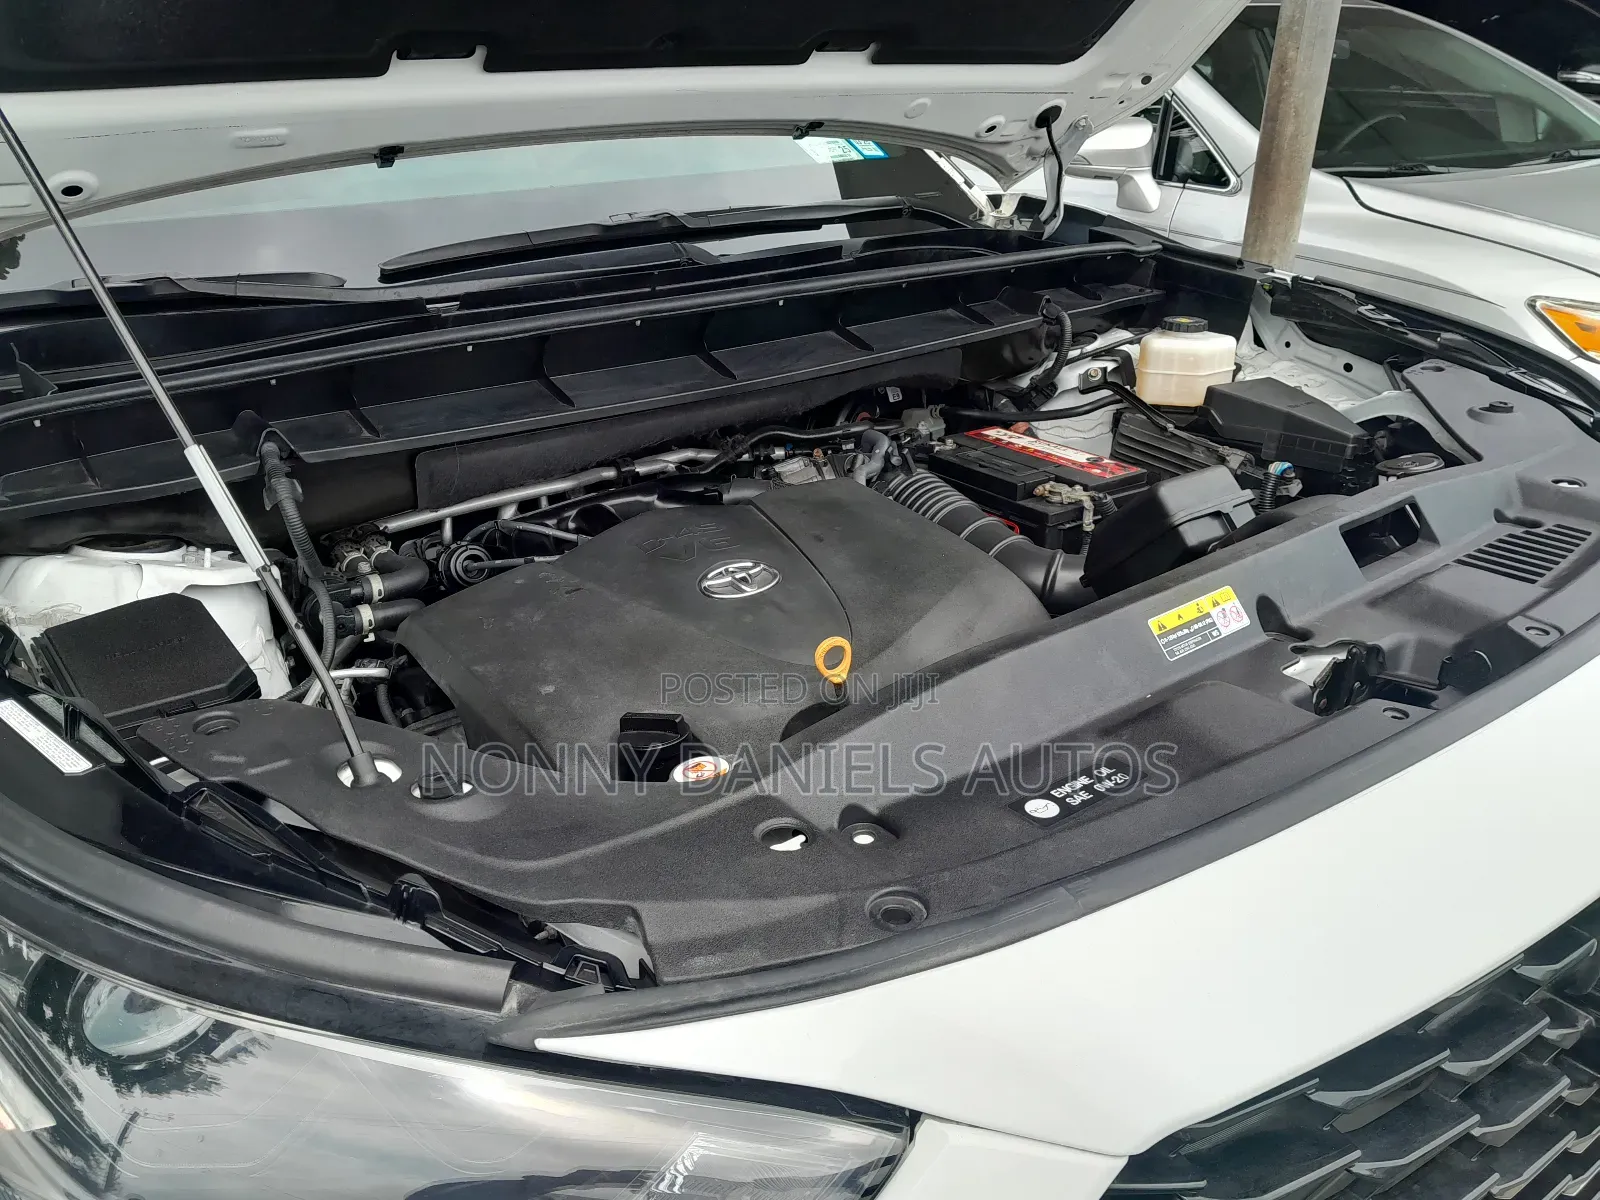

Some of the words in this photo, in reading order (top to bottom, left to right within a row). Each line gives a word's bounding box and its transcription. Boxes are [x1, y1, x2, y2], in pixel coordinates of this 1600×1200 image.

[1049, 775, 1094, 798] ENGINE
[1093, 766, 1116, 777] OIL
[1065, 790, 1094, 806] SAE
[1093, 772, 1129, 792] 0W-20
